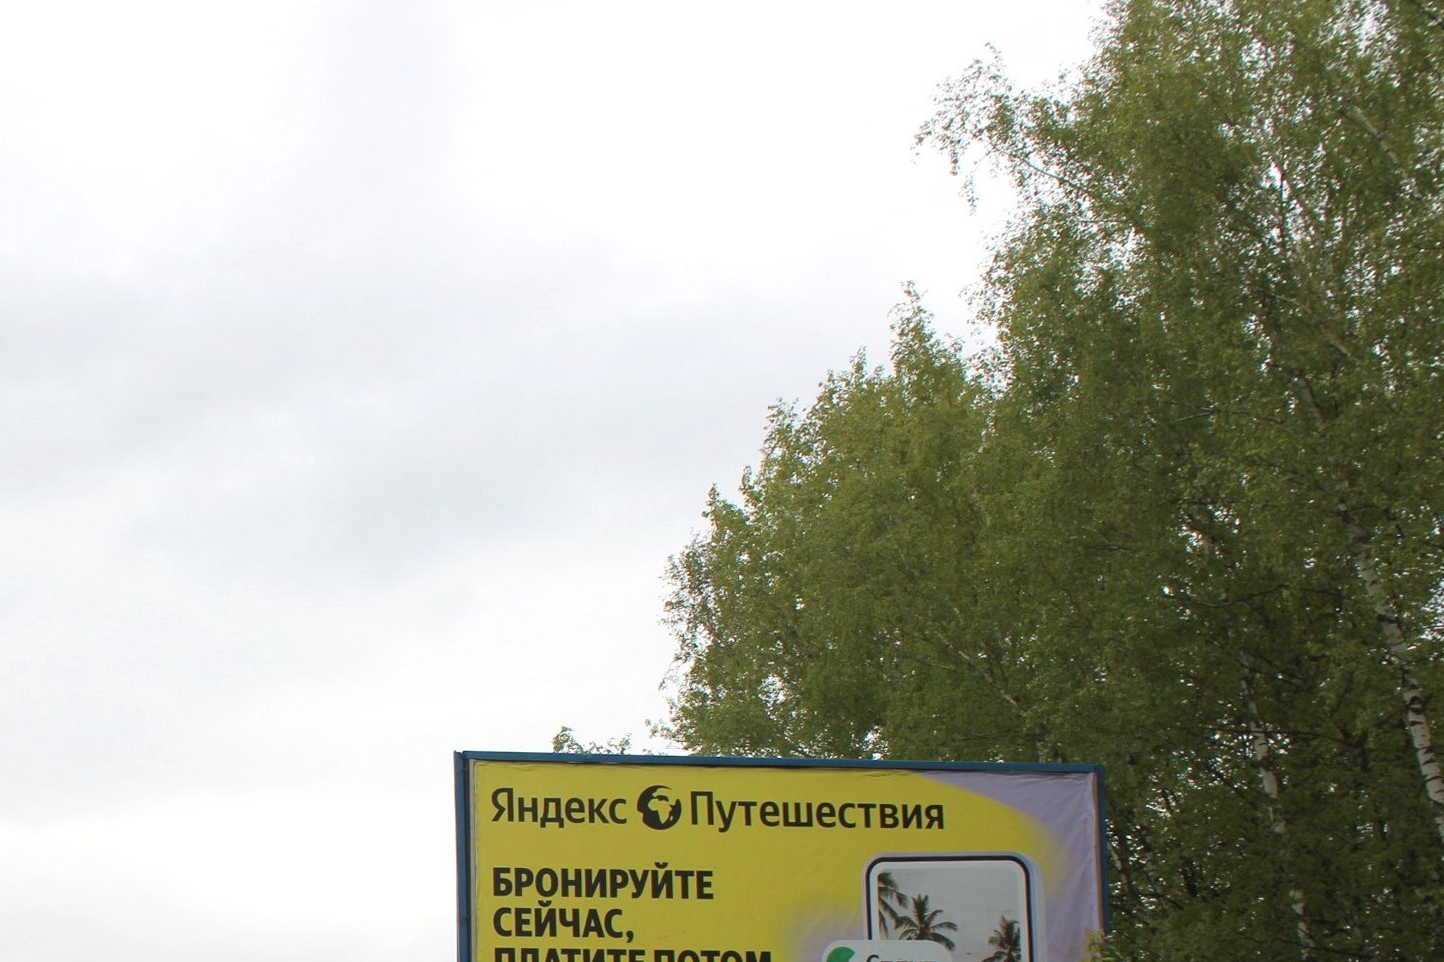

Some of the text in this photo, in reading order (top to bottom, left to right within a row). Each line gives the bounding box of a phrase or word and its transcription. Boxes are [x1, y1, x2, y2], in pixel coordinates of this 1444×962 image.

[491, 787, 945, 832] Яндекс Путешествия
[492, 862, 714, 900] БРОНИРУЙТЕ
[493, 900, 634, 943] СЕЙЧАС,
